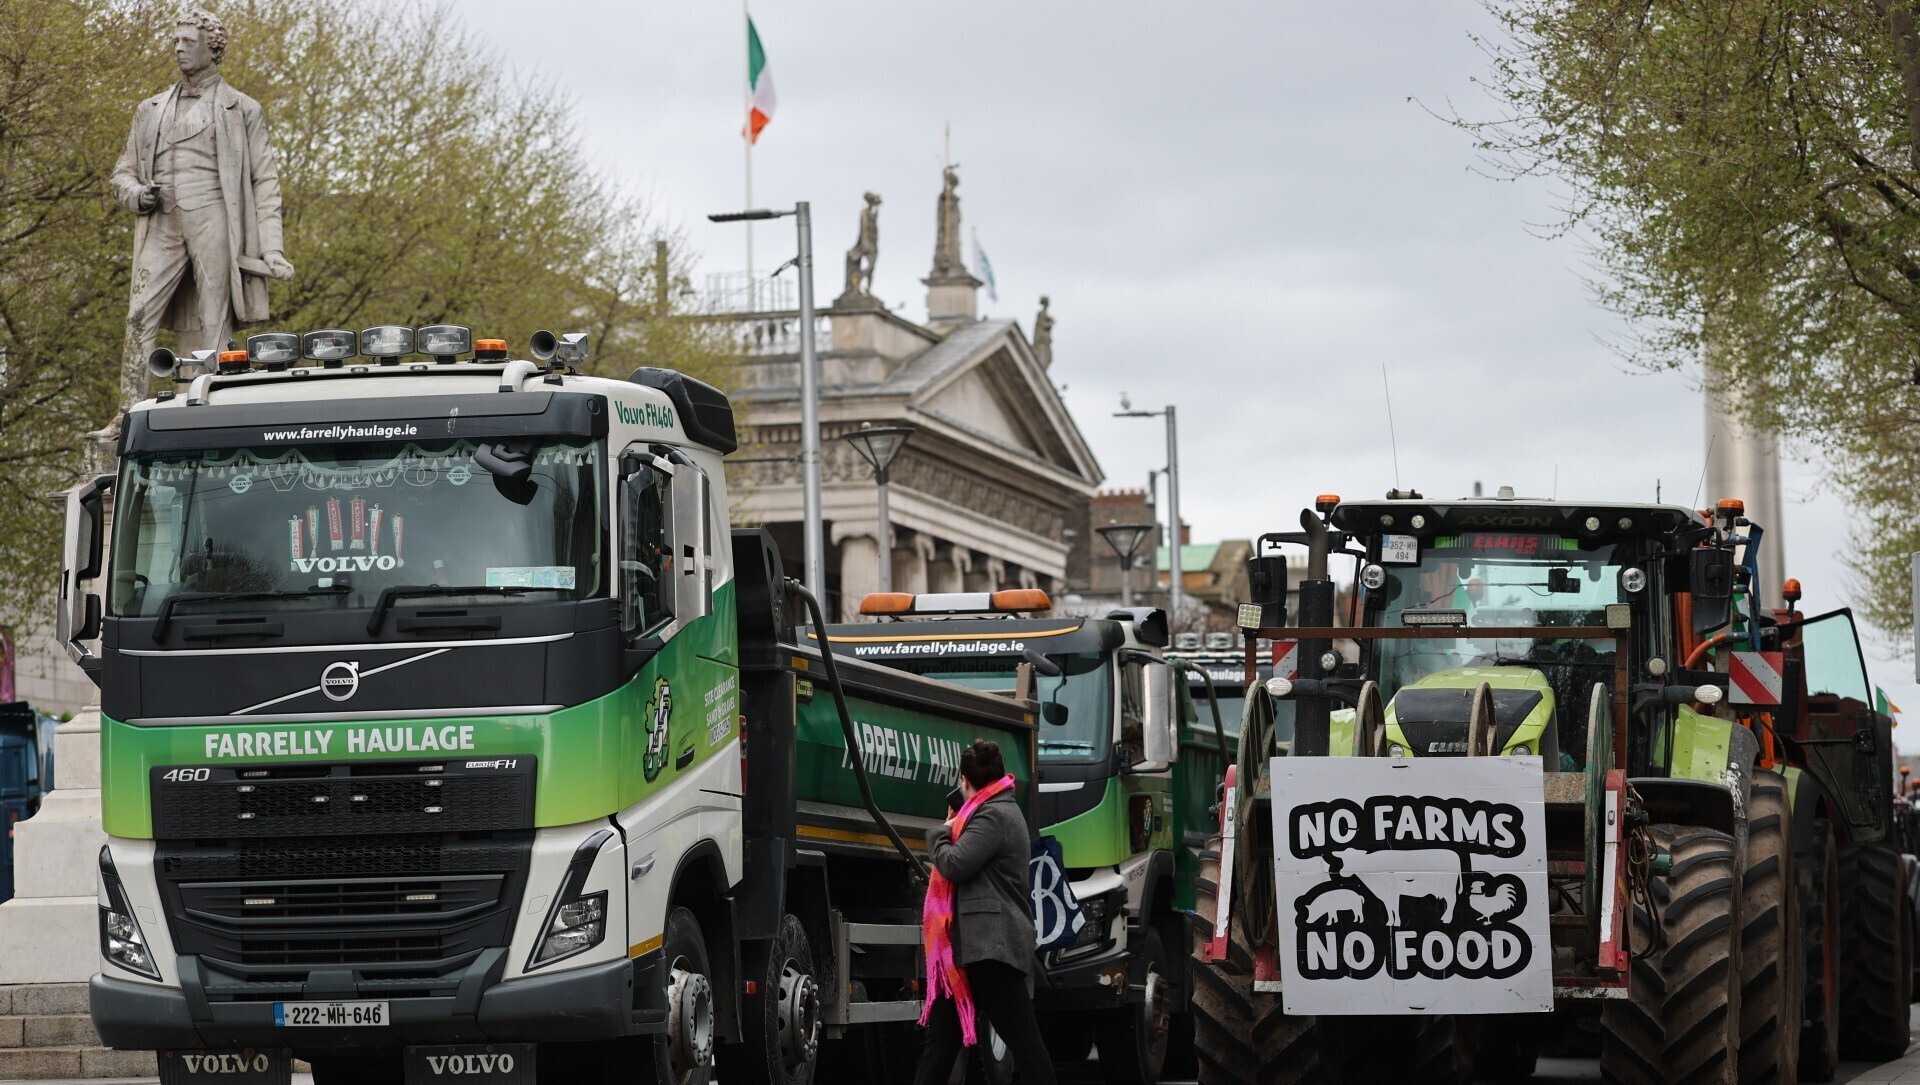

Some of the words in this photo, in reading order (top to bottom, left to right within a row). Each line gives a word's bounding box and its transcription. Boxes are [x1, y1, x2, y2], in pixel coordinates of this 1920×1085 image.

[645, 403, 674, 429] FH460
[263, 423, 417, 441] www.farrellyhaulage.ie
[267, 464, 439, 492] VOLVO
[1473, 535, 1540, 549] CLAAS
[293, 555, 396, 573] VOLVO
[1395, 551, 1409, 560] 494
[855, 640, 1025, 656] www.farrellyhaulage.ie
[205, 729, 333, 758] FARRELLY
[347, 725, 475, 753] HAULAGE
[495, 759, 517, 770] FH
[162, 768, 211, 782] 460
[1299, 808, 1358, 850] NO
[1373, 805, 1517, 849] FARMS
[1306, 931, 1375, 970] NO
[1394, 930, 1522, 970] FOOD
[292, 1007, 382, 1024] 222-MH-646
[182, 1054, 269, 1074] VOLVO
[426, 1053, 514, 1075] VOLVO
